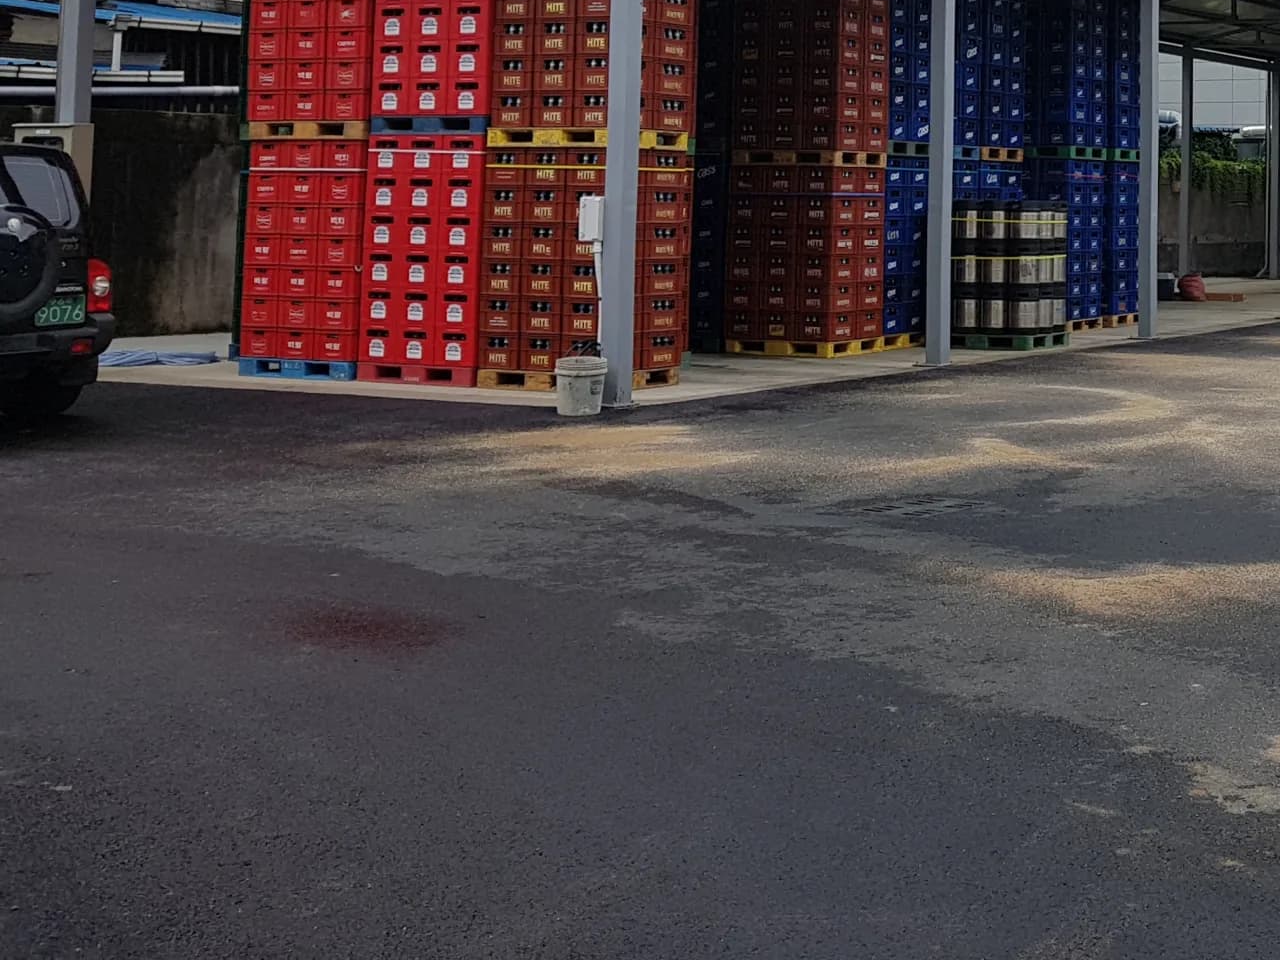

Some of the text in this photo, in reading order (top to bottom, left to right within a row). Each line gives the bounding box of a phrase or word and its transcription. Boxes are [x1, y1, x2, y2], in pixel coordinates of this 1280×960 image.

[507, 4, 524, 13] HITE
[546, 2, 565, 12] HITE
[505, 40, 523, 49] HITE
[545, 39, 563, 48] HITE
[587, 38, 605, 48] HITE
[504, 76, 521, 85] HITE
[545, 75, 563, 84] HITE
[587, 75, 605, 84] HITE
[543, 112, 562, 121] HITE
[585, 112, 604, 121] HITE
[536, 170, 555, 179] HITE
[577, 170, 595, 180] HITE
[494, 207, 512, 216] HITE
[534, 207, 552, 216] HITE
[492, 243, 510, 253] HITE
[491, 279, 508, 289] HITE
[532, 281, 550, 290] HITE
[574, 282, 593, 291] HITE
[38, 305, 83, 323] 9076
[531, 317, 549, 327] HITE
[574, 319, 593, 329] HITE
[489, 353, 507, 363] HITE
[531, 355, 549, 365] HITE
